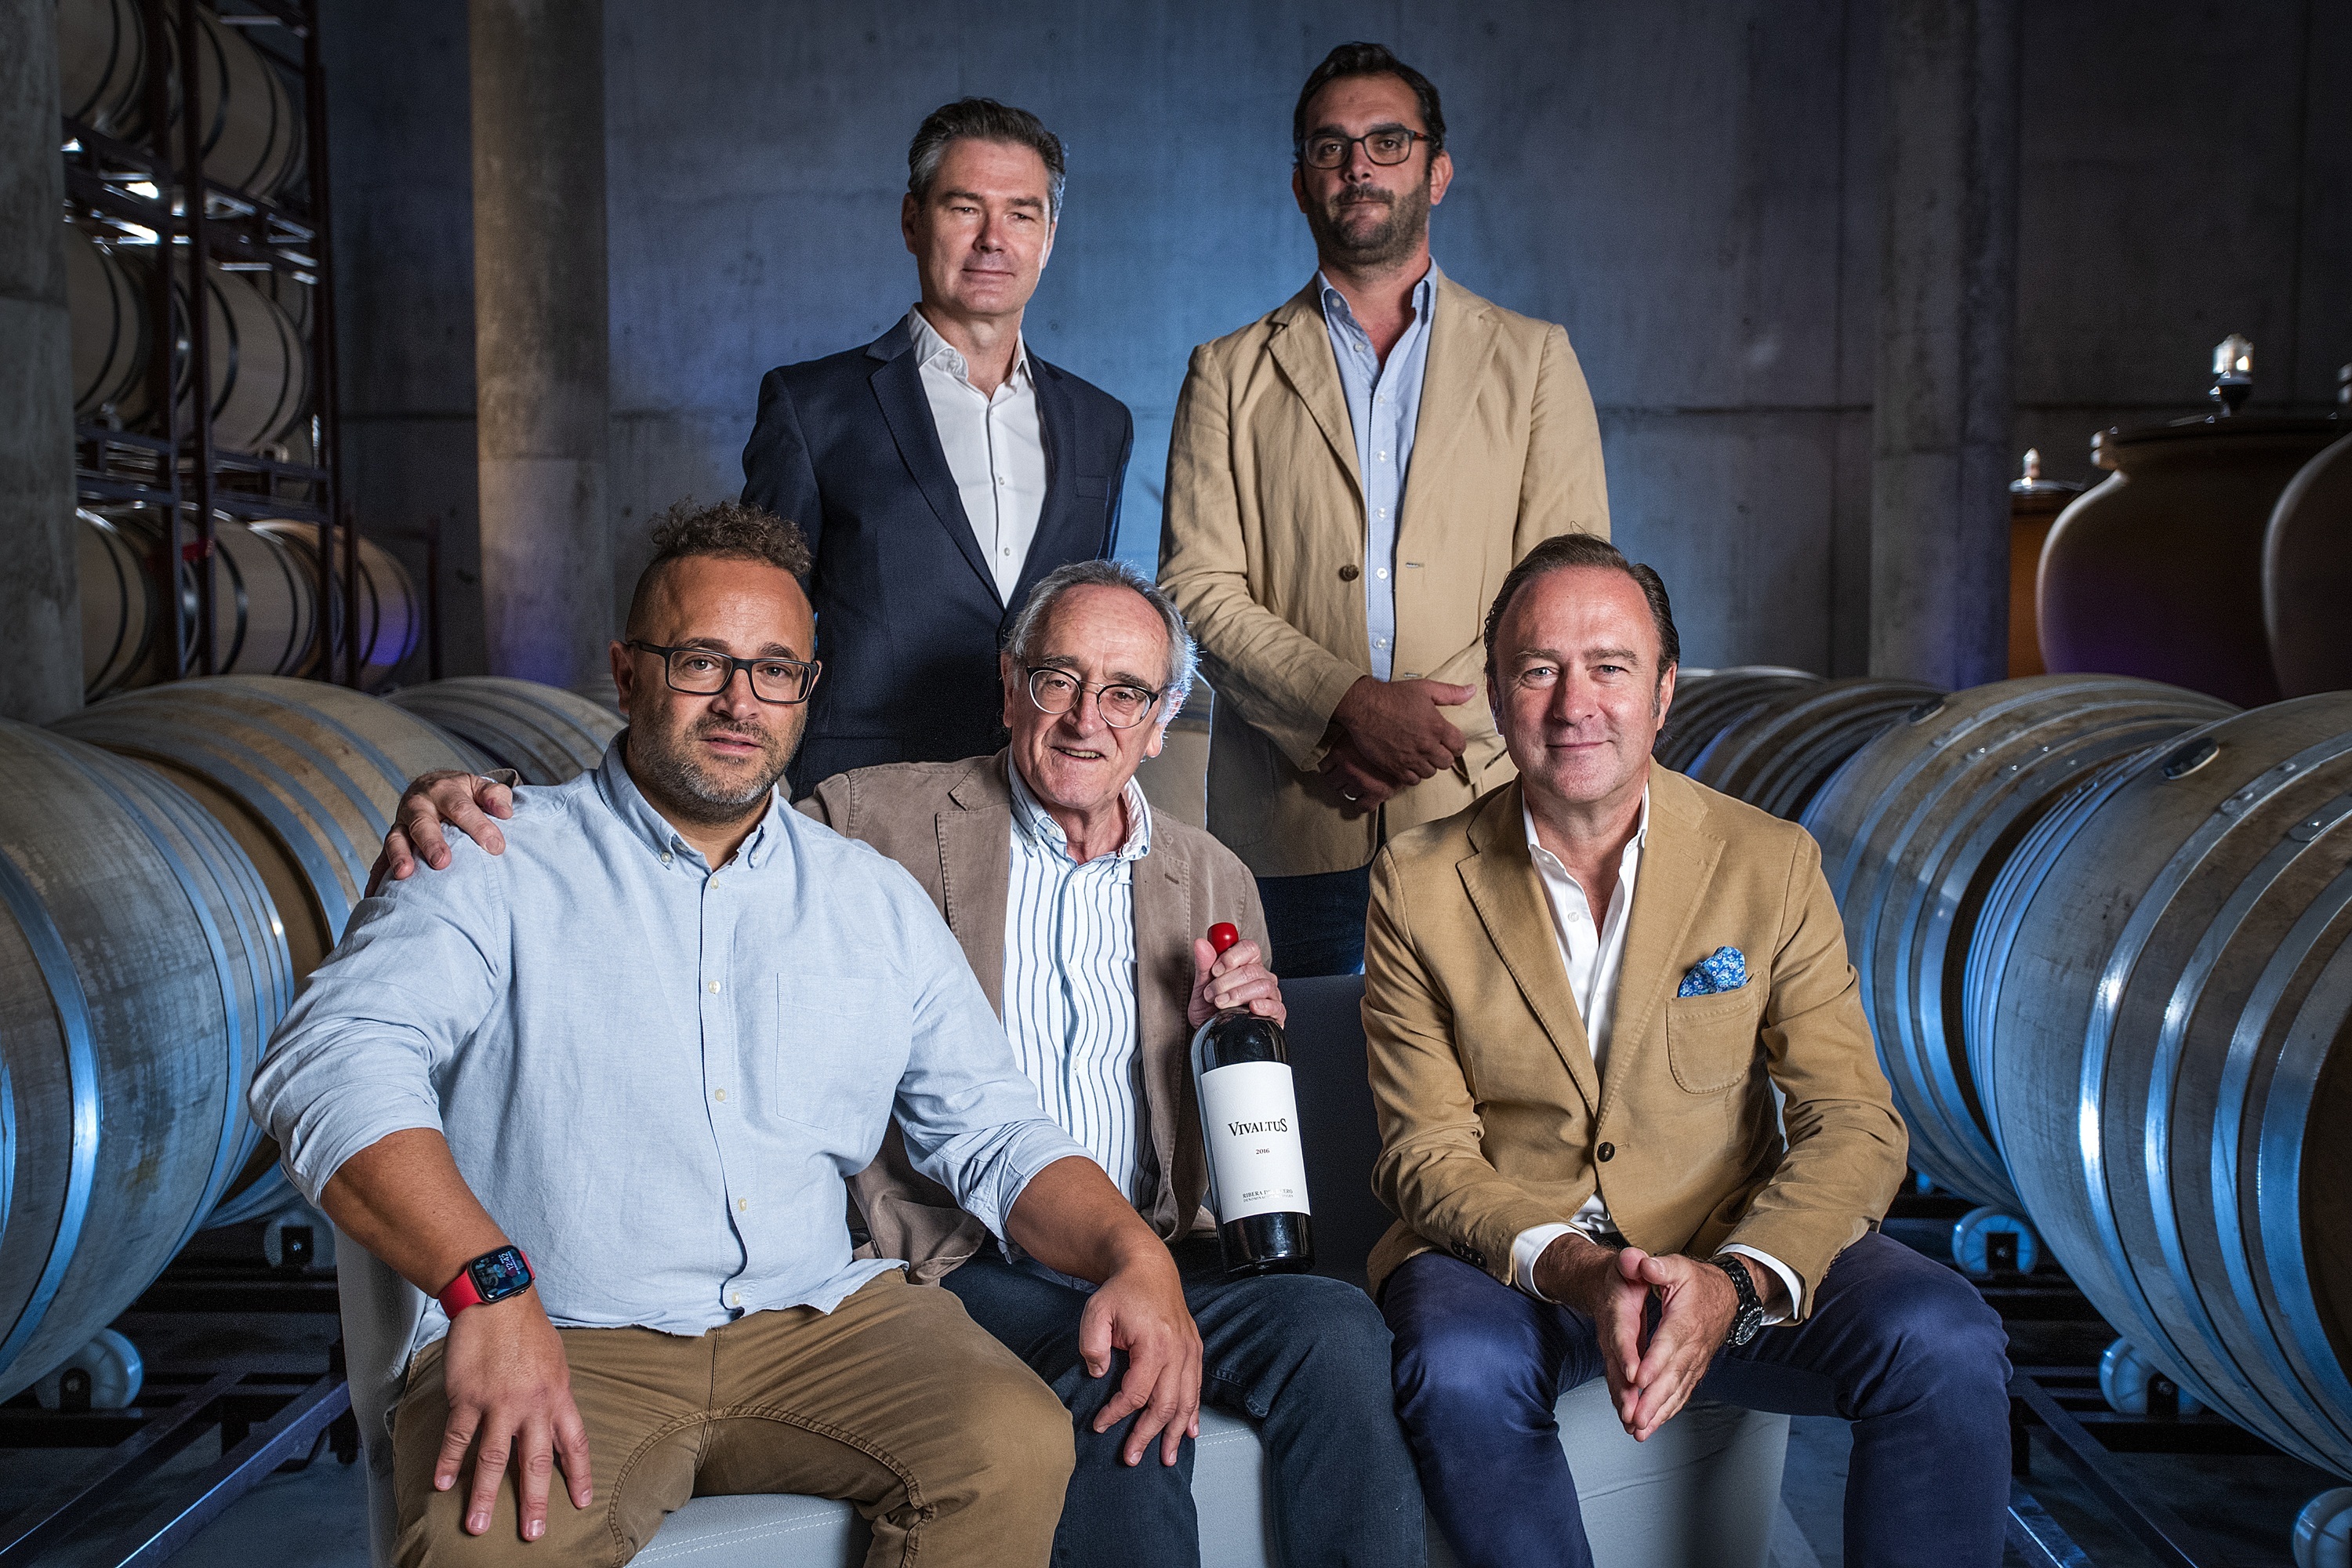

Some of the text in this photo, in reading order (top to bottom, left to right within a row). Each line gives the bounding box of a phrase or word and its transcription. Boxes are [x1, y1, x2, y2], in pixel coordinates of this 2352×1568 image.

[1228, 1118, 1287, 1136] VIVALTUS
[1243, 1190, 1262, 1199] RIBERA
[502, 1253, 514, 1271] 12:42
